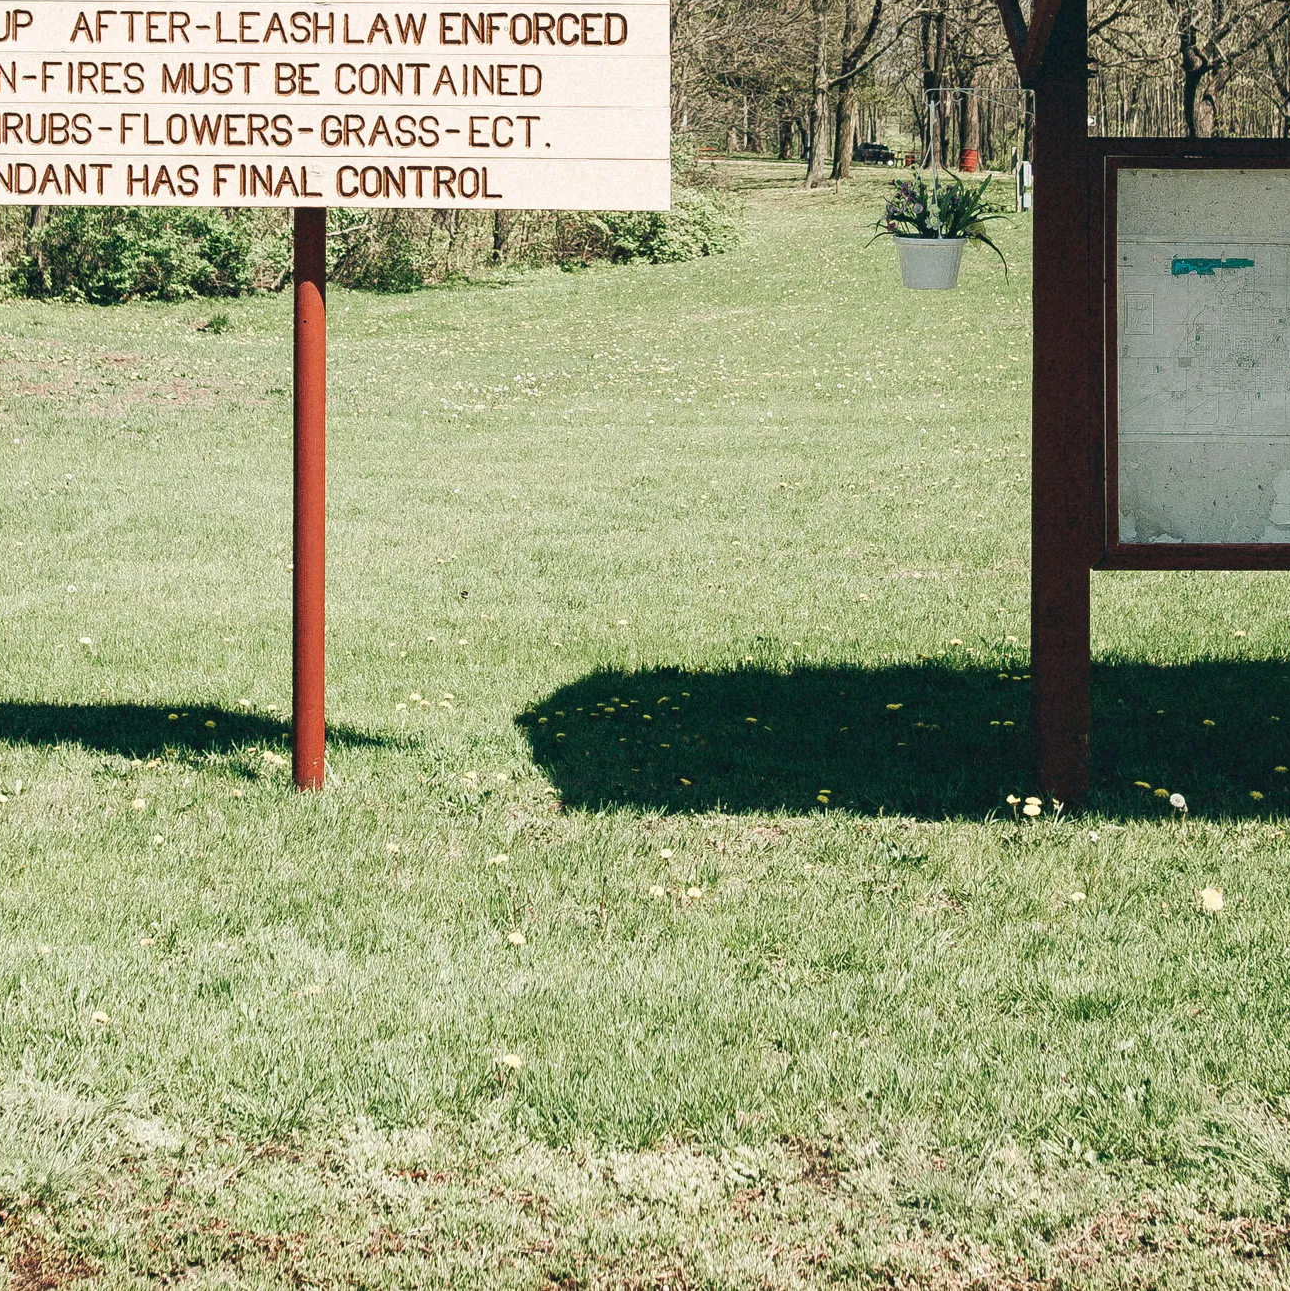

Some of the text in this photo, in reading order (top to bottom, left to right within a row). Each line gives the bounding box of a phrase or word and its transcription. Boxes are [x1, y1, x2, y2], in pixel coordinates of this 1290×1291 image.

[439, 12, 628, 46] ENFORCED
[161, 61, 261, 95] MUST
[274, 62, 320, 96] BE
[334, 62, 543, 97] CONTAINED
[126, 163, 200, 198] HAS
[213, 163, 323, 198] FINAL
[336, 164, 503, 200] CONTROL
